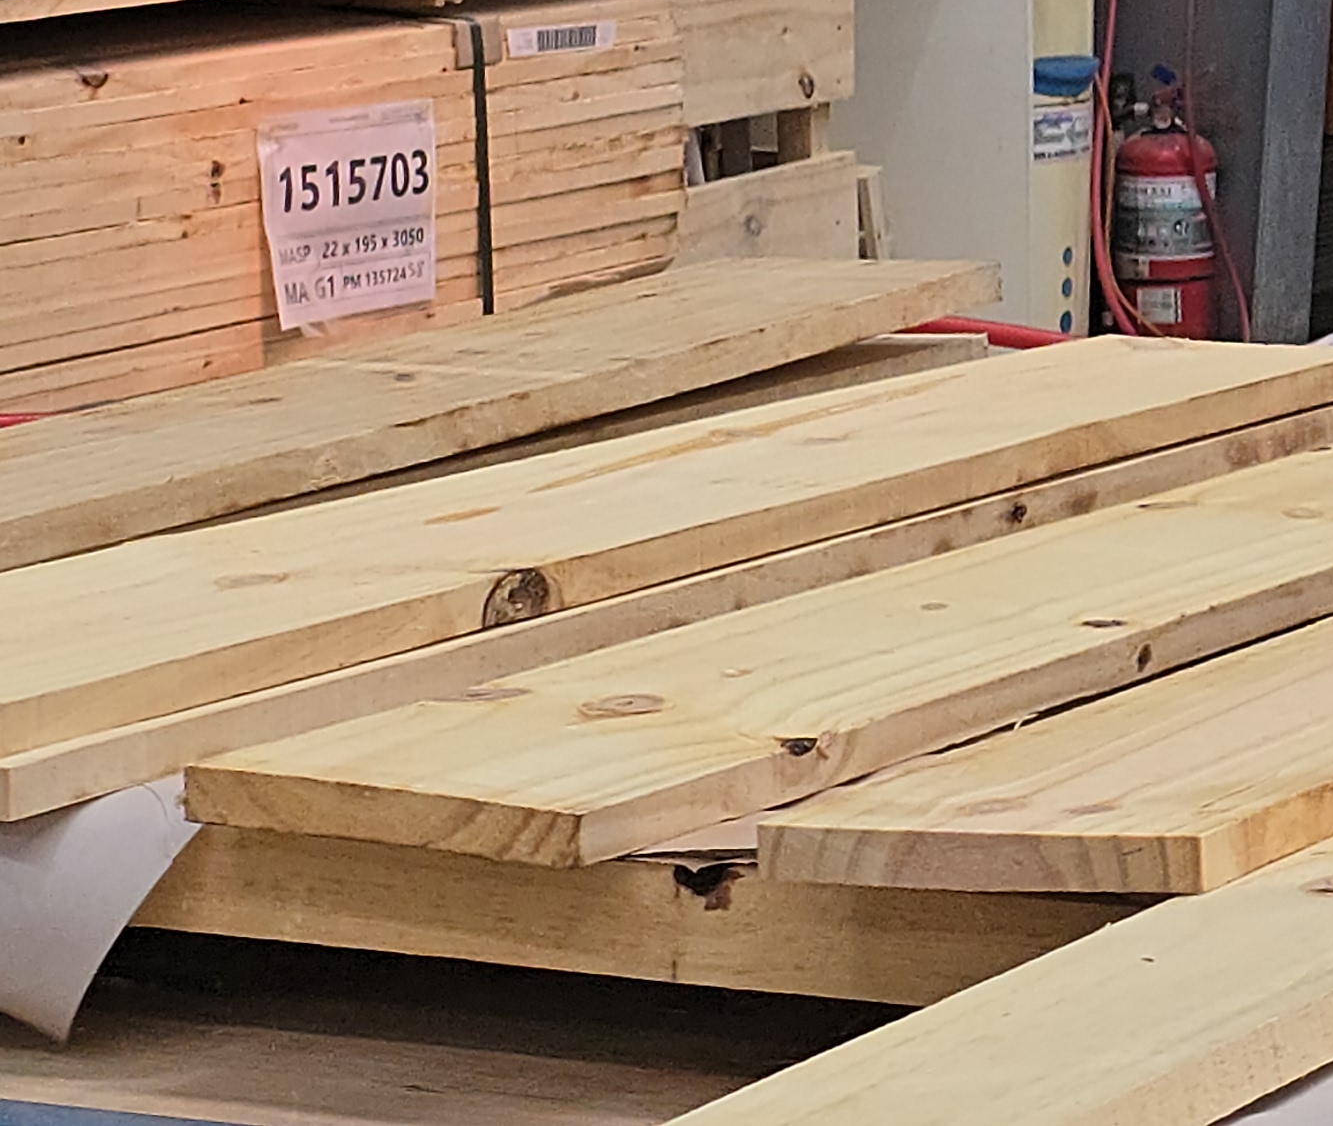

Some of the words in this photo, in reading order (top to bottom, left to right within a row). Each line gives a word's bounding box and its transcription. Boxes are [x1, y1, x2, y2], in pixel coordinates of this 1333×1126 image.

[279, 149, 430, 213] 1515703
[322, 241, 338, 259] 22
[355, 234, 378, 253] 195
[392, 227, 425, 247] 3050
[284, 280, 311, 305] MA
[314, 275, 336, 298] G1
